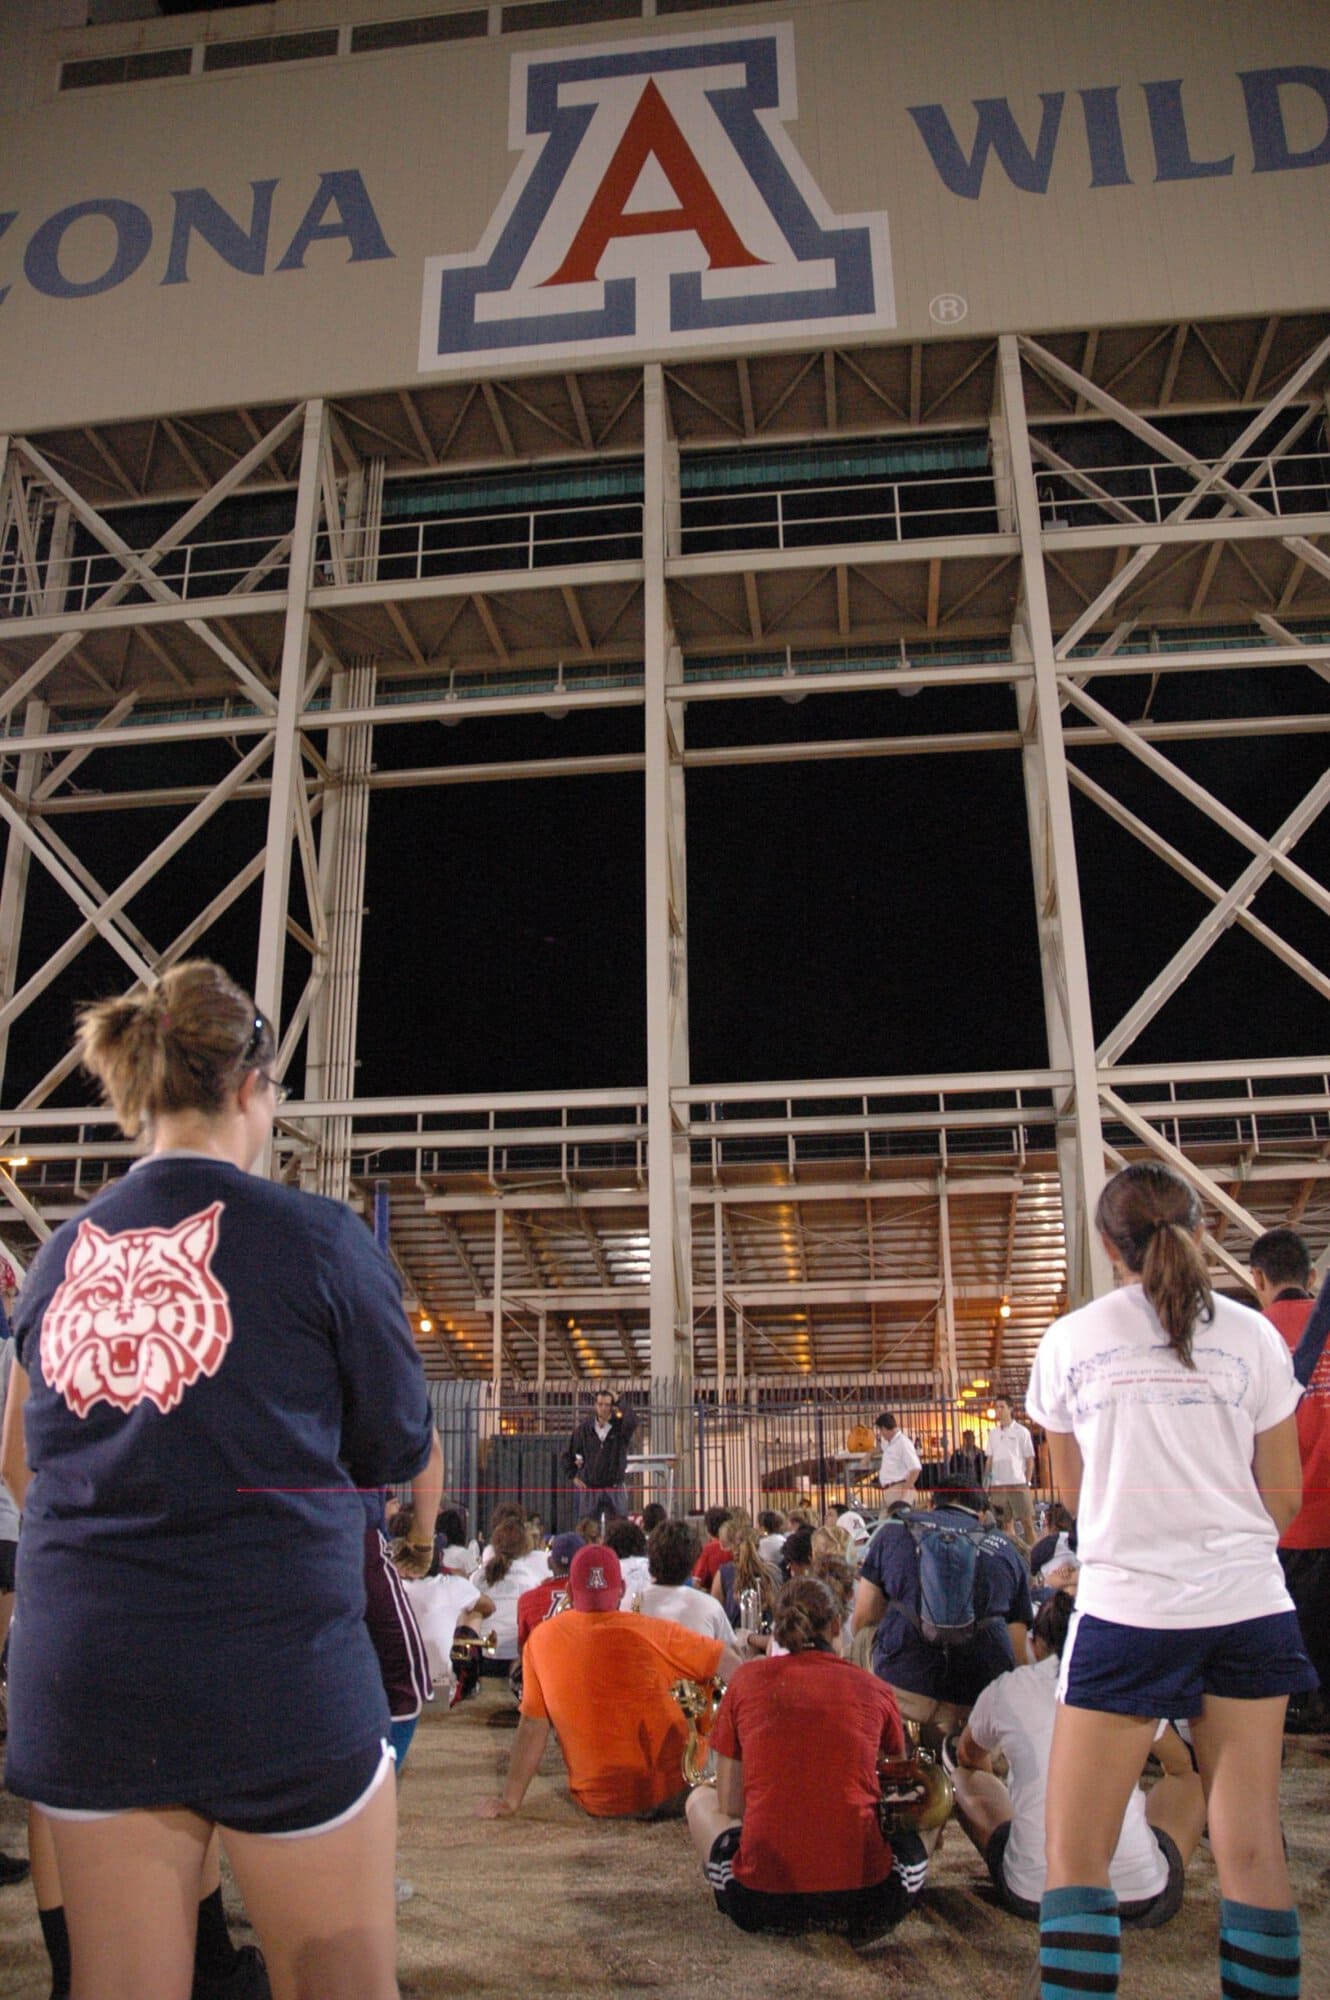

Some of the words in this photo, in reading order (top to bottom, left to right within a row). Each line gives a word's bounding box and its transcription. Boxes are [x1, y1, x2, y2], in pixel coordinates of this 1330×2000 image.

[0, 168, 397, 303] ONA
[418, 20, 897, 373] A
[586, 1567, 609, 1589] A
